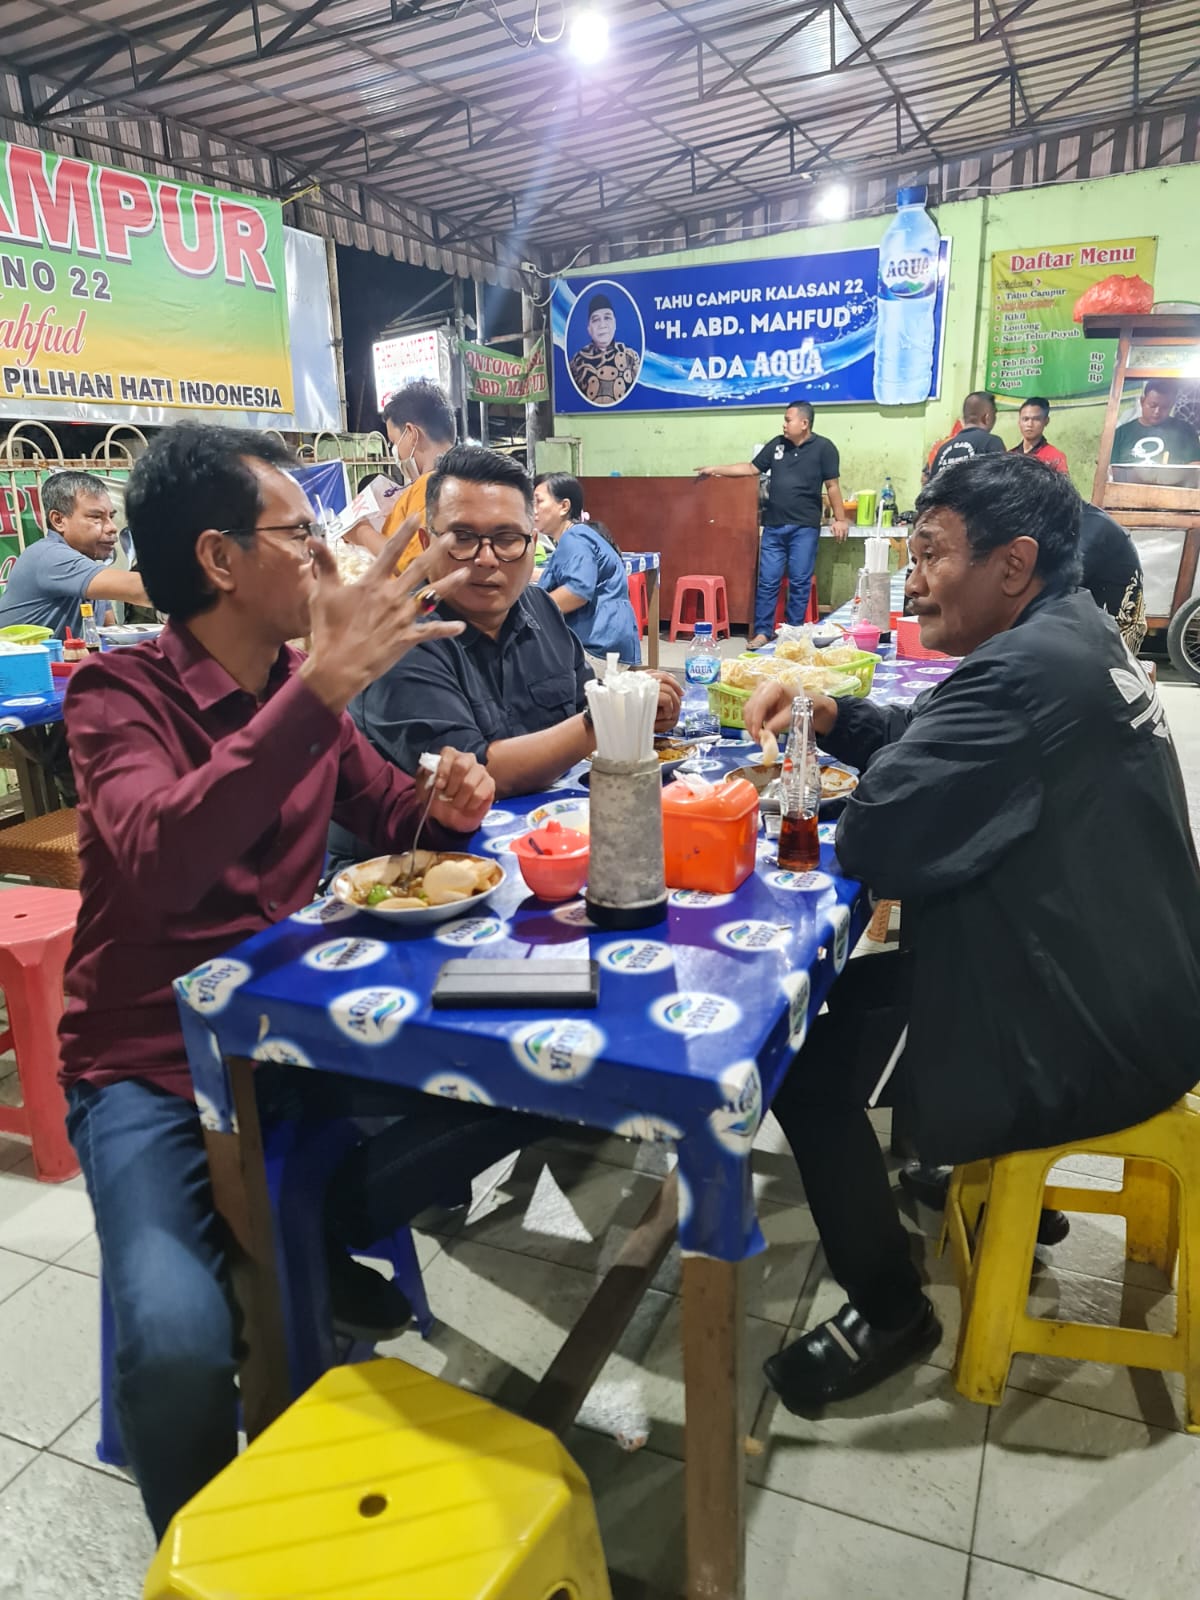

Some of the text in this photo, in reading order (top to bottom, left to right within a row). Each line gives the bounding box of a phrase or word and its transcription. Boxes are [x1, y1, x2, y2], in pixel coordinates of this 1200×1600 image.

[0, 143, 275, 292] MPUR
[886, 256, 929, 279] AQUA
[1011, 246, 1136, 273] Daftar Menu
[69, 266, 112, 301] 22
[654, 279, 863, 310] TAHU CAMPUR KALASAN 22
[1030, 289, 1067, 298] Campur
[691, 316, 745, 337] ABD.
[1003, 323, 1040, 332] Lontong
[688, 348, 825, 380] ADA AQUA
[4, 367, 282, 408] PILIHAN HATI INDONESIA
[1000, 380, 1021, 388] Aqua
[689, 664, 713, 674] AQUA
